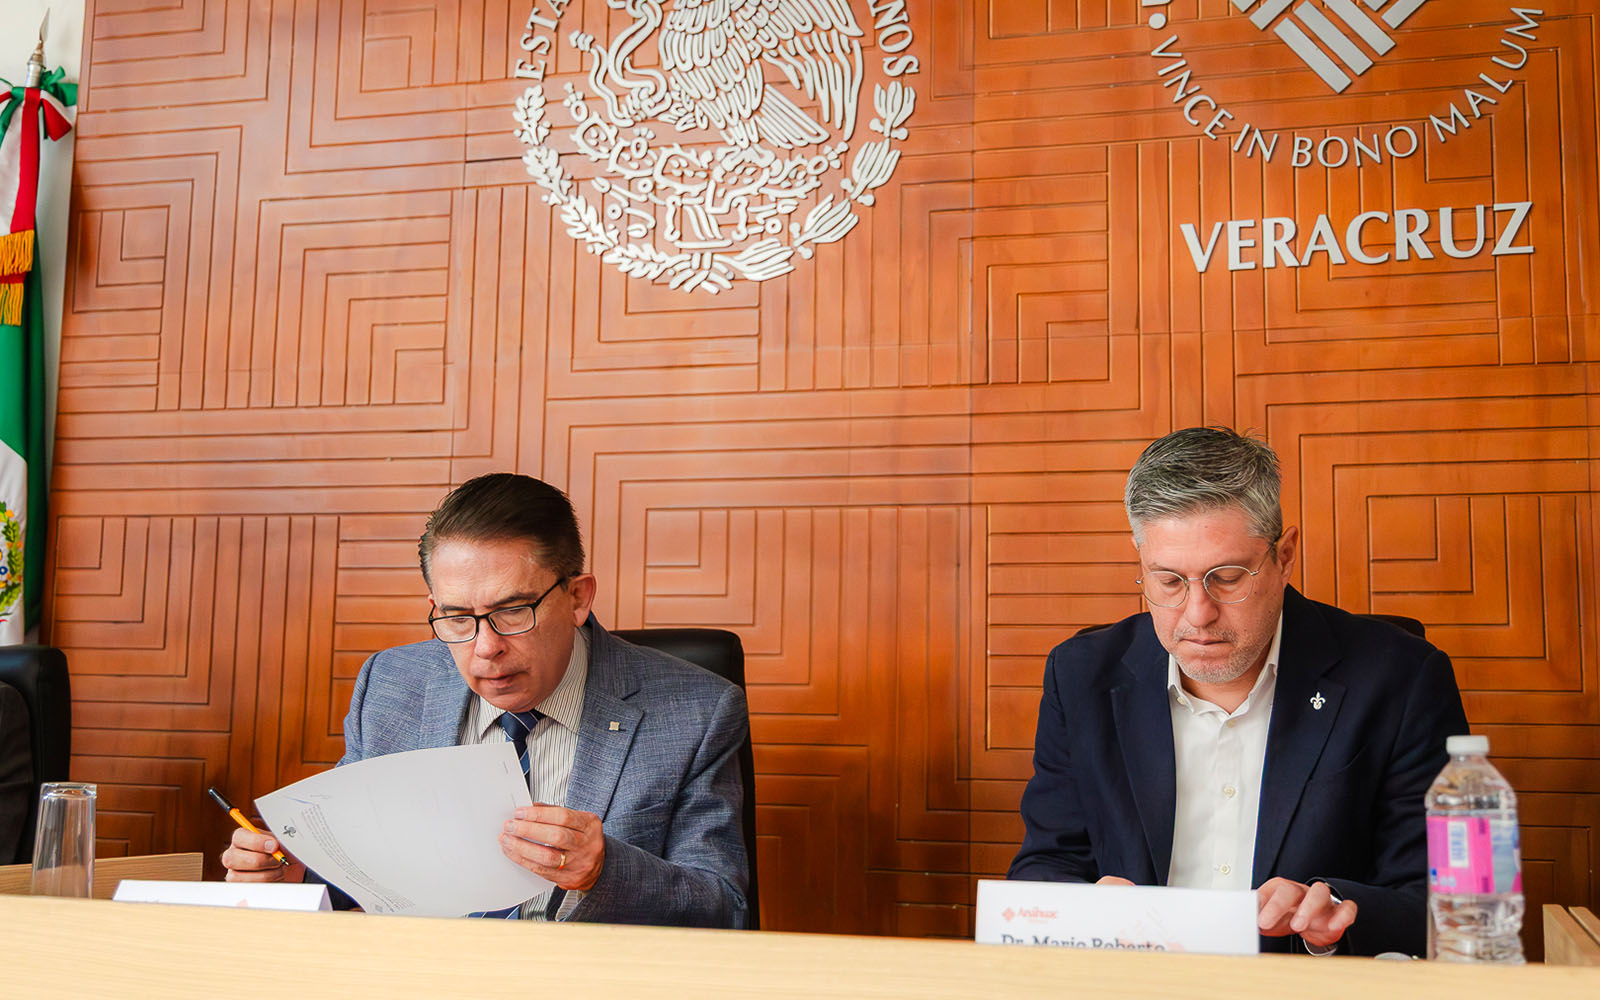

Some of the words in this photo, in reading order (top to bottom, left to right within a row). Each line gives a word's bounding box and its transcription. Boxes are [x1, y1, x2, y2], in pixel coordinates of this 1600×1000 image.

[1151, 34, 1233, 140] VINCE
[1233, 123, 1278, 163] IN
[1291, 126, 1419, 168] BONO
[1428, 7, 1544, 144] MALUM
[1180, 201, 1535, 273] VERACRUZ
